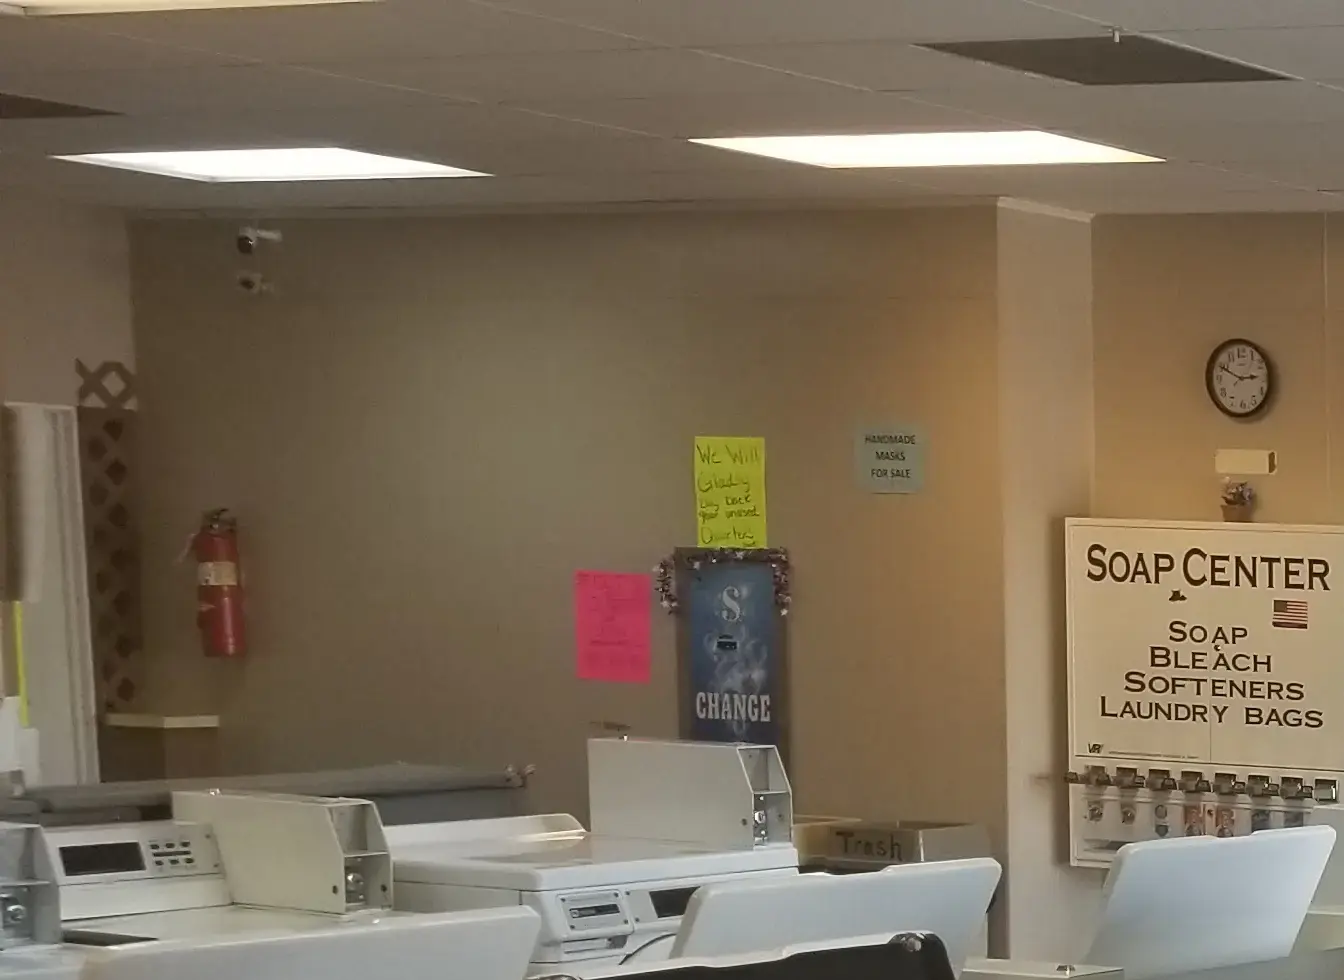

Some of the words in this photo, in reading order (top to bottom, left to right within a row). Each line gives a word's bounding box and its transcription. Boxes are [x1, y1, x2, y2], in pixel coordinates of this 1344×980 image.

[864, 434, 916, 445] HANDMADE
[696, 444, 722, 464] We
[875, 451, 906, 461] MASKS
[871, 468, 887, 478] FOR
[890, 469, 911, 479] SALE
[1087, 543, 1175, 584] SOAP
[1182, 548, 1331, 591] CENTER
[1168, 620, 1248, 645] SOAP
[1149, 645, 1272, 673] BLEACH
[1123, 671, 1305, 701] SOFTENERS
[696, 692, 771, 722] CHANGE
[1100, 695, 1229, 724] LAUNDRY
[1244, 706, 1324, 729] BAGS
[836, 831, 903, 861] Trash
